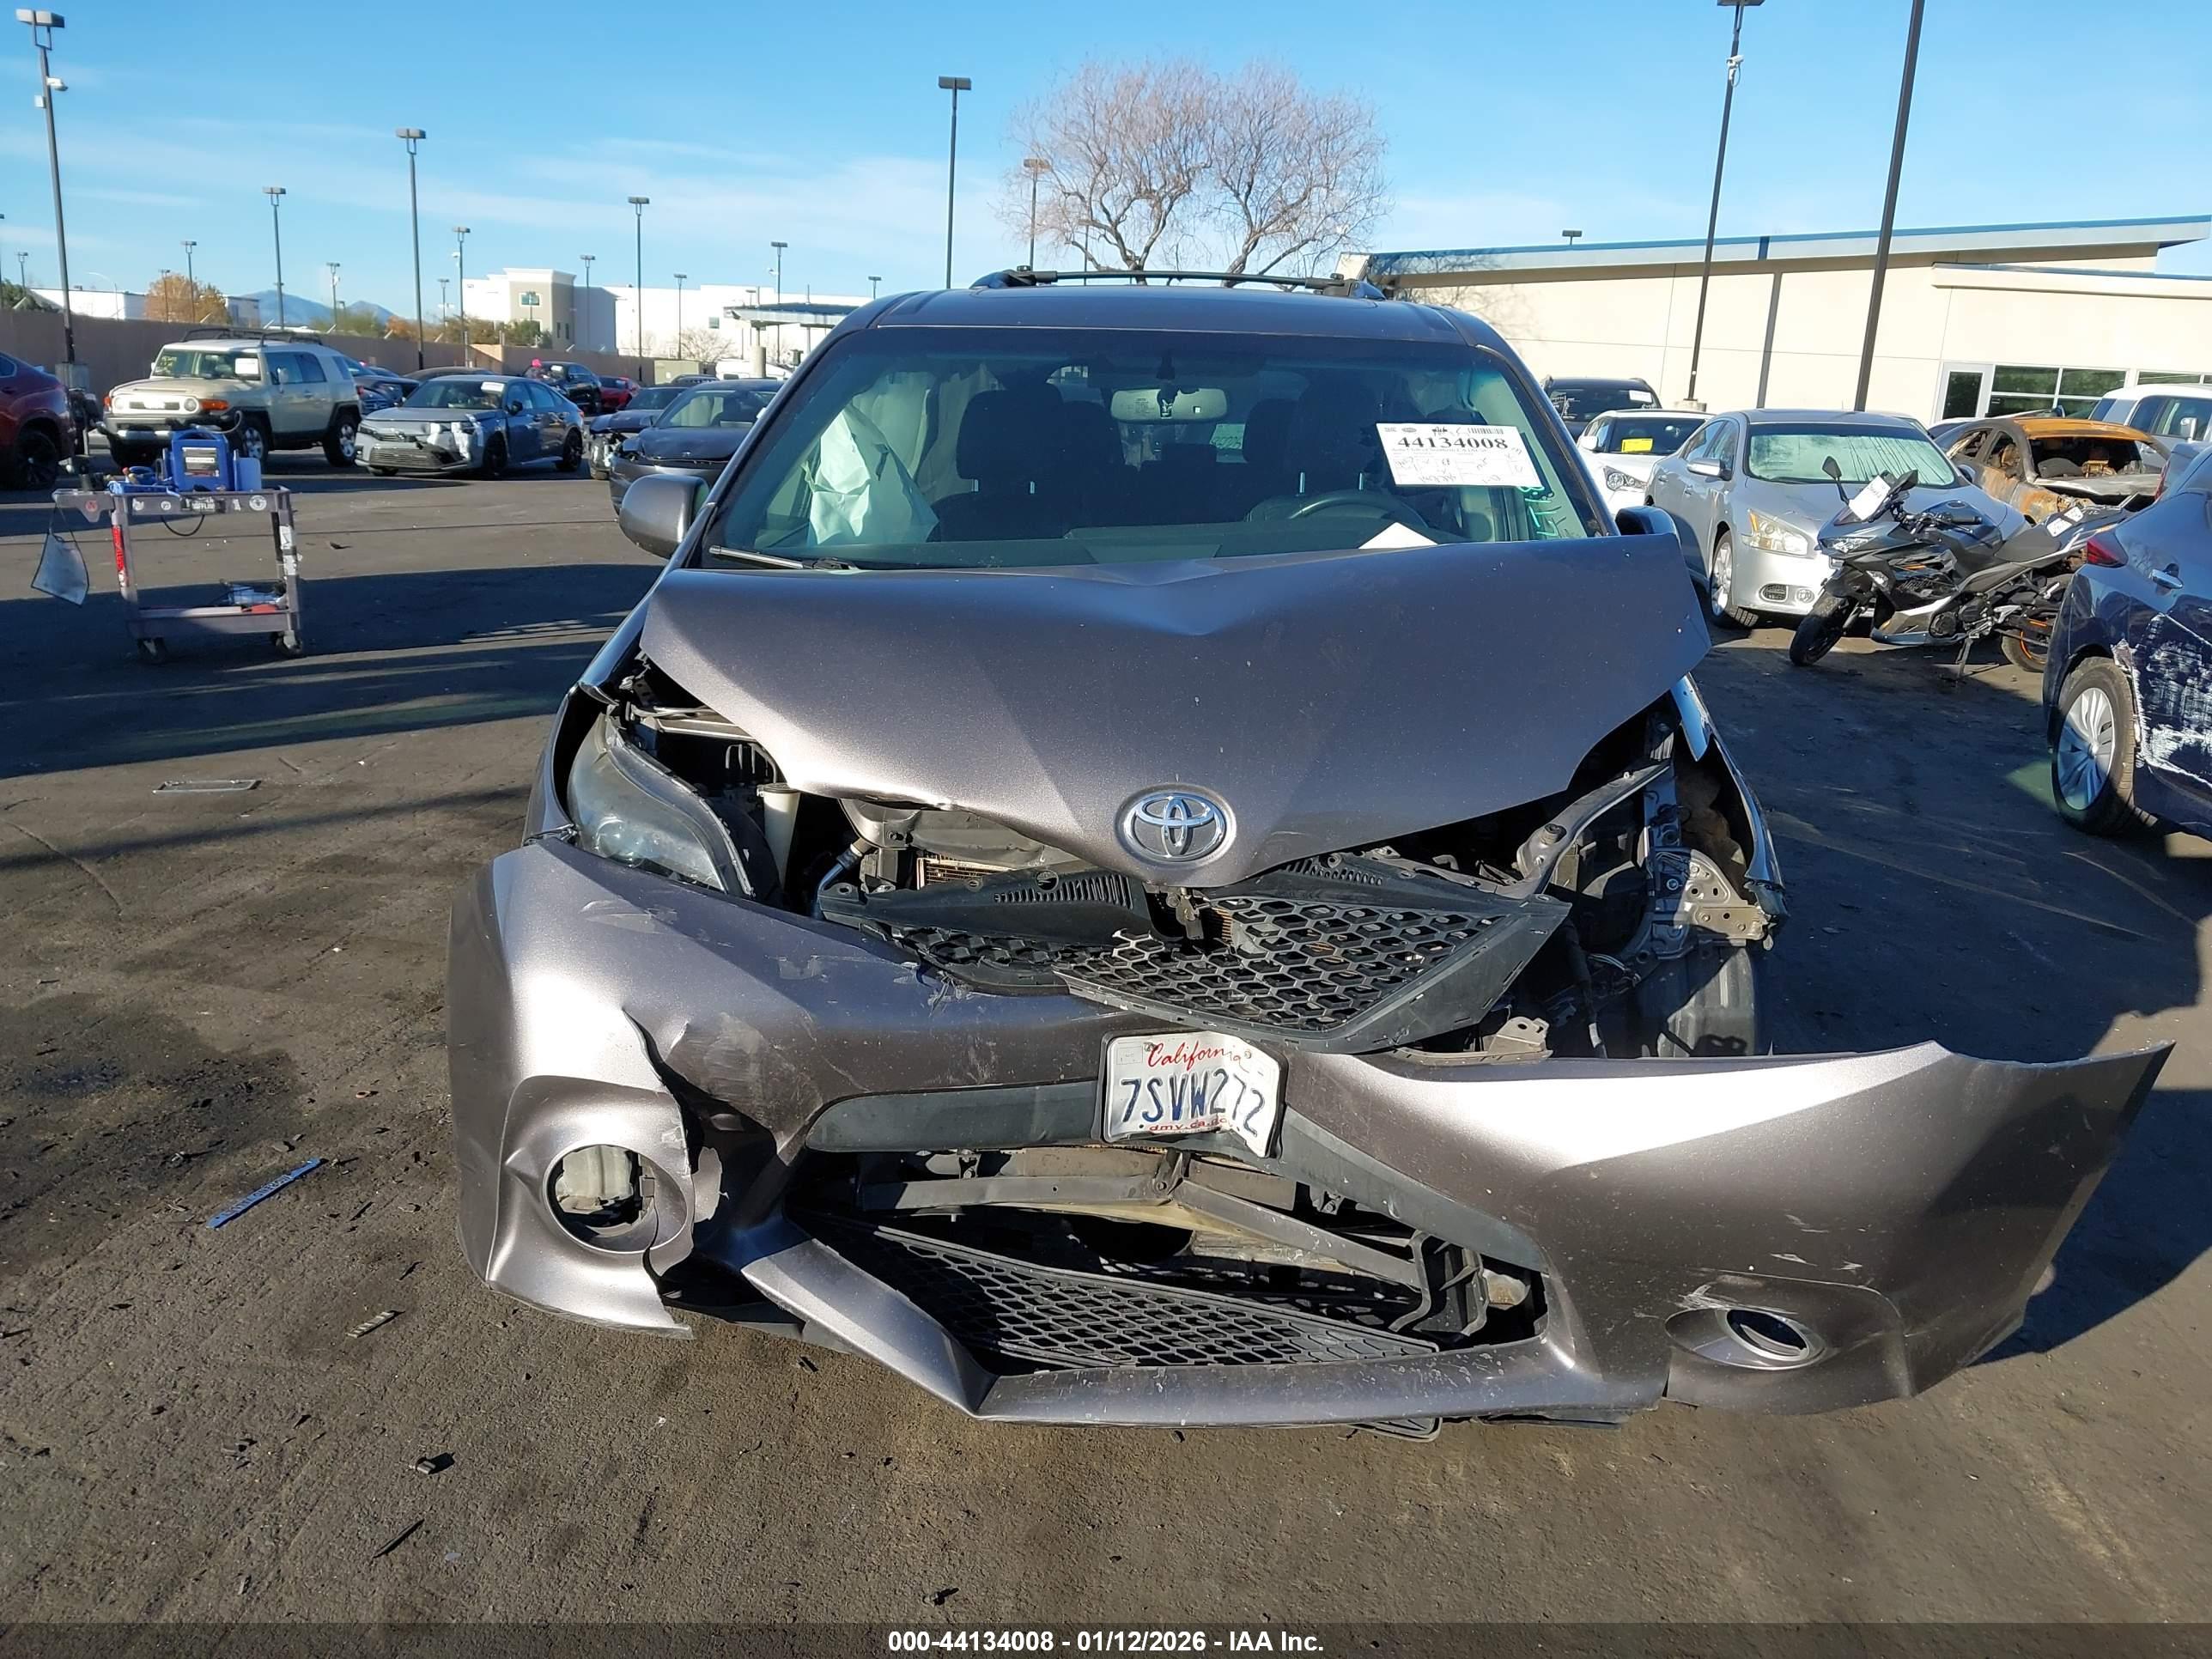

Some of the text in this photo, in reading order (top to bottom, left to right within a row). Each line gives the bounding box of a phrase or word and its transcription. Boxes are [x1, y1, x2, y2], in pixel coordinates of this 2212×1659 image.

[1397, 436, 1508, 449] 44134008
[1146, 1040, 1249, 1073] California
[1121, 1067, 1267, 1138] 7SVW272
